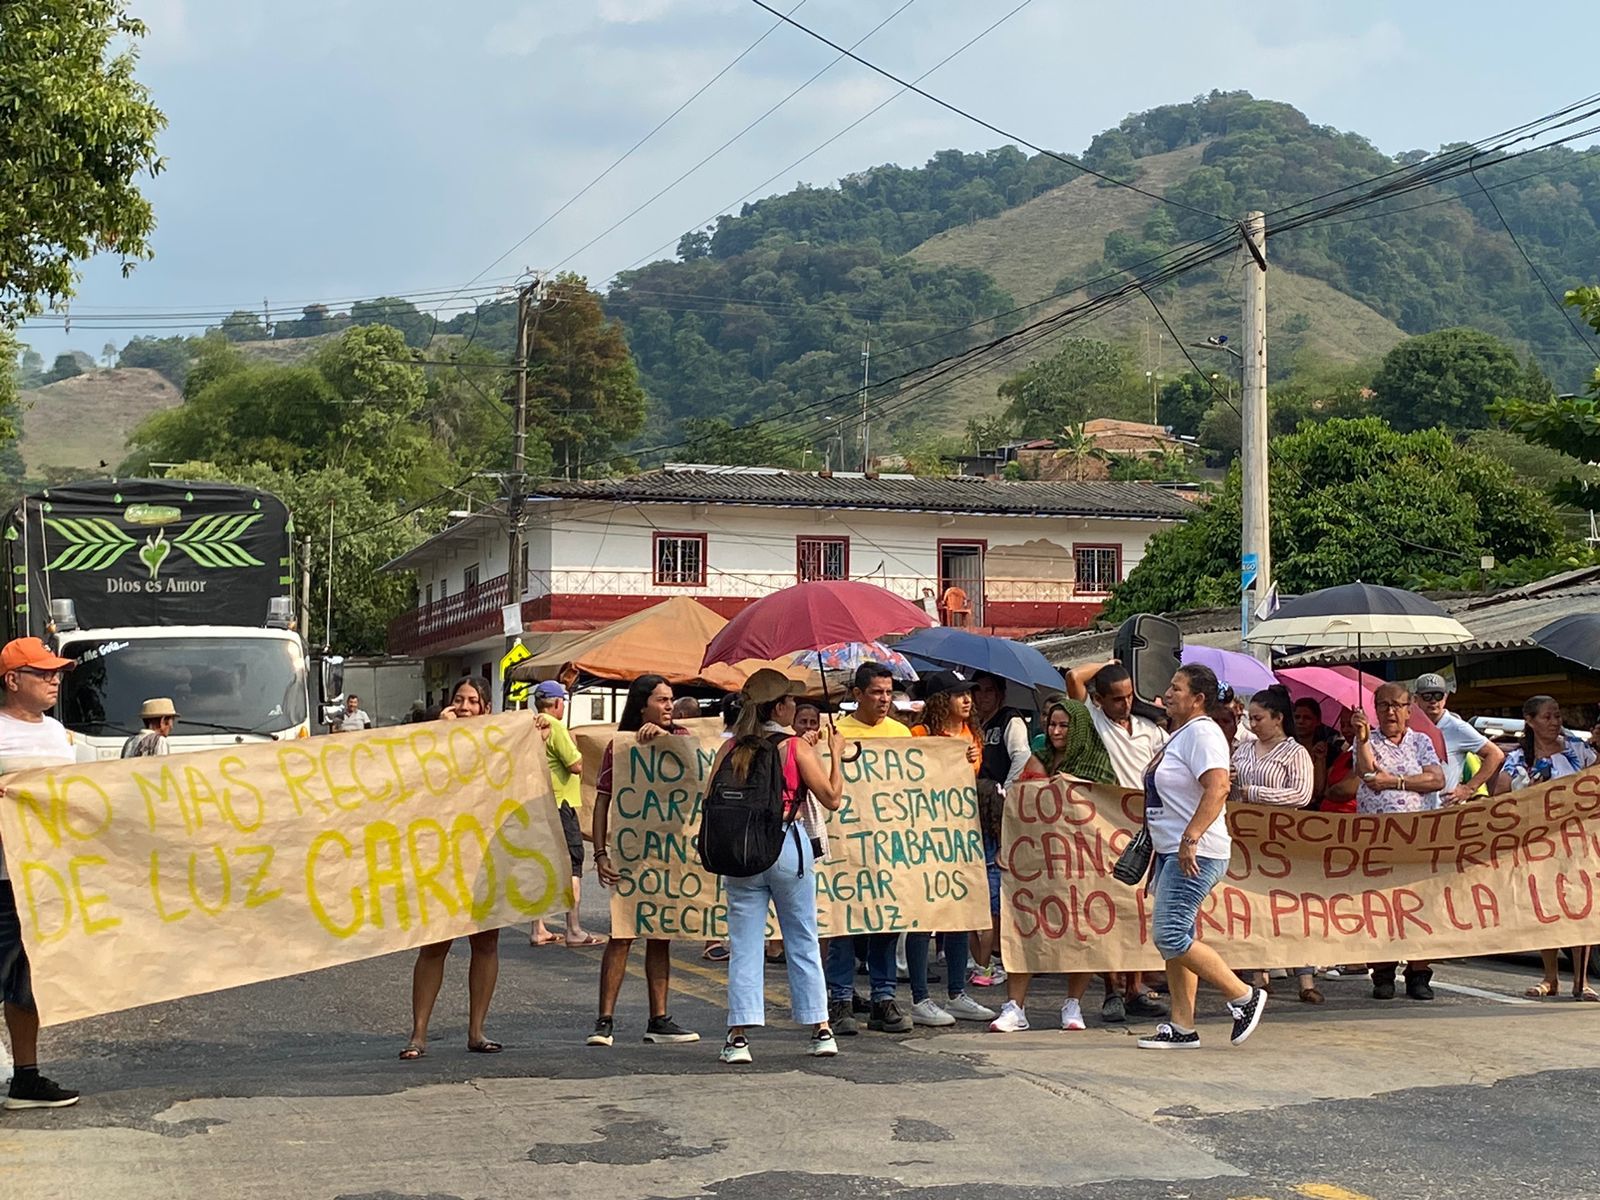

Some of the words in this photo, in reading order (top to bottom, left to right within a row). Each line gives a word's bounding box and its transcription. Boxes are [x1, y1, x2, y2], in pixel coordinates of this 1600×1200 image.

[106, 577, 141, 593] Dios
[145, 580, 162, 593] es
[165, 577, 207, 593] Amor
[630, 745, 685, 784] NO
[17, 774, 113, 853] NO
[131, 756, 265, 837] MAS
[277, 725, 515, 816] RECIBOS
[616, 787, 704, 826] CARA
[872, 787, 978, 828] ESTAMOS
[1018, 782, 1096, 826] LOS
[1121, 792, 1522, 846] CERCIANTES
[846, 827, 984, 870] TRABAJAR
[1323, 846, 1394, 879] DE
[20, 854, 123, 942] DE
[150, 842, 285, 923] LUZ
[616, 867, 702, 899] SOLO
[815, 869, 897, 902] AGAR
[923, 870, 969, 902] LOS
[846, 904, 919, 933] LUZ.
[1012, 884, 1116, 942] SOLO
[1269, 883, 1434, 940] PAGAR
[1444, 883, 1500, 931] LA
[1527, 869, 1600, 924] LU
